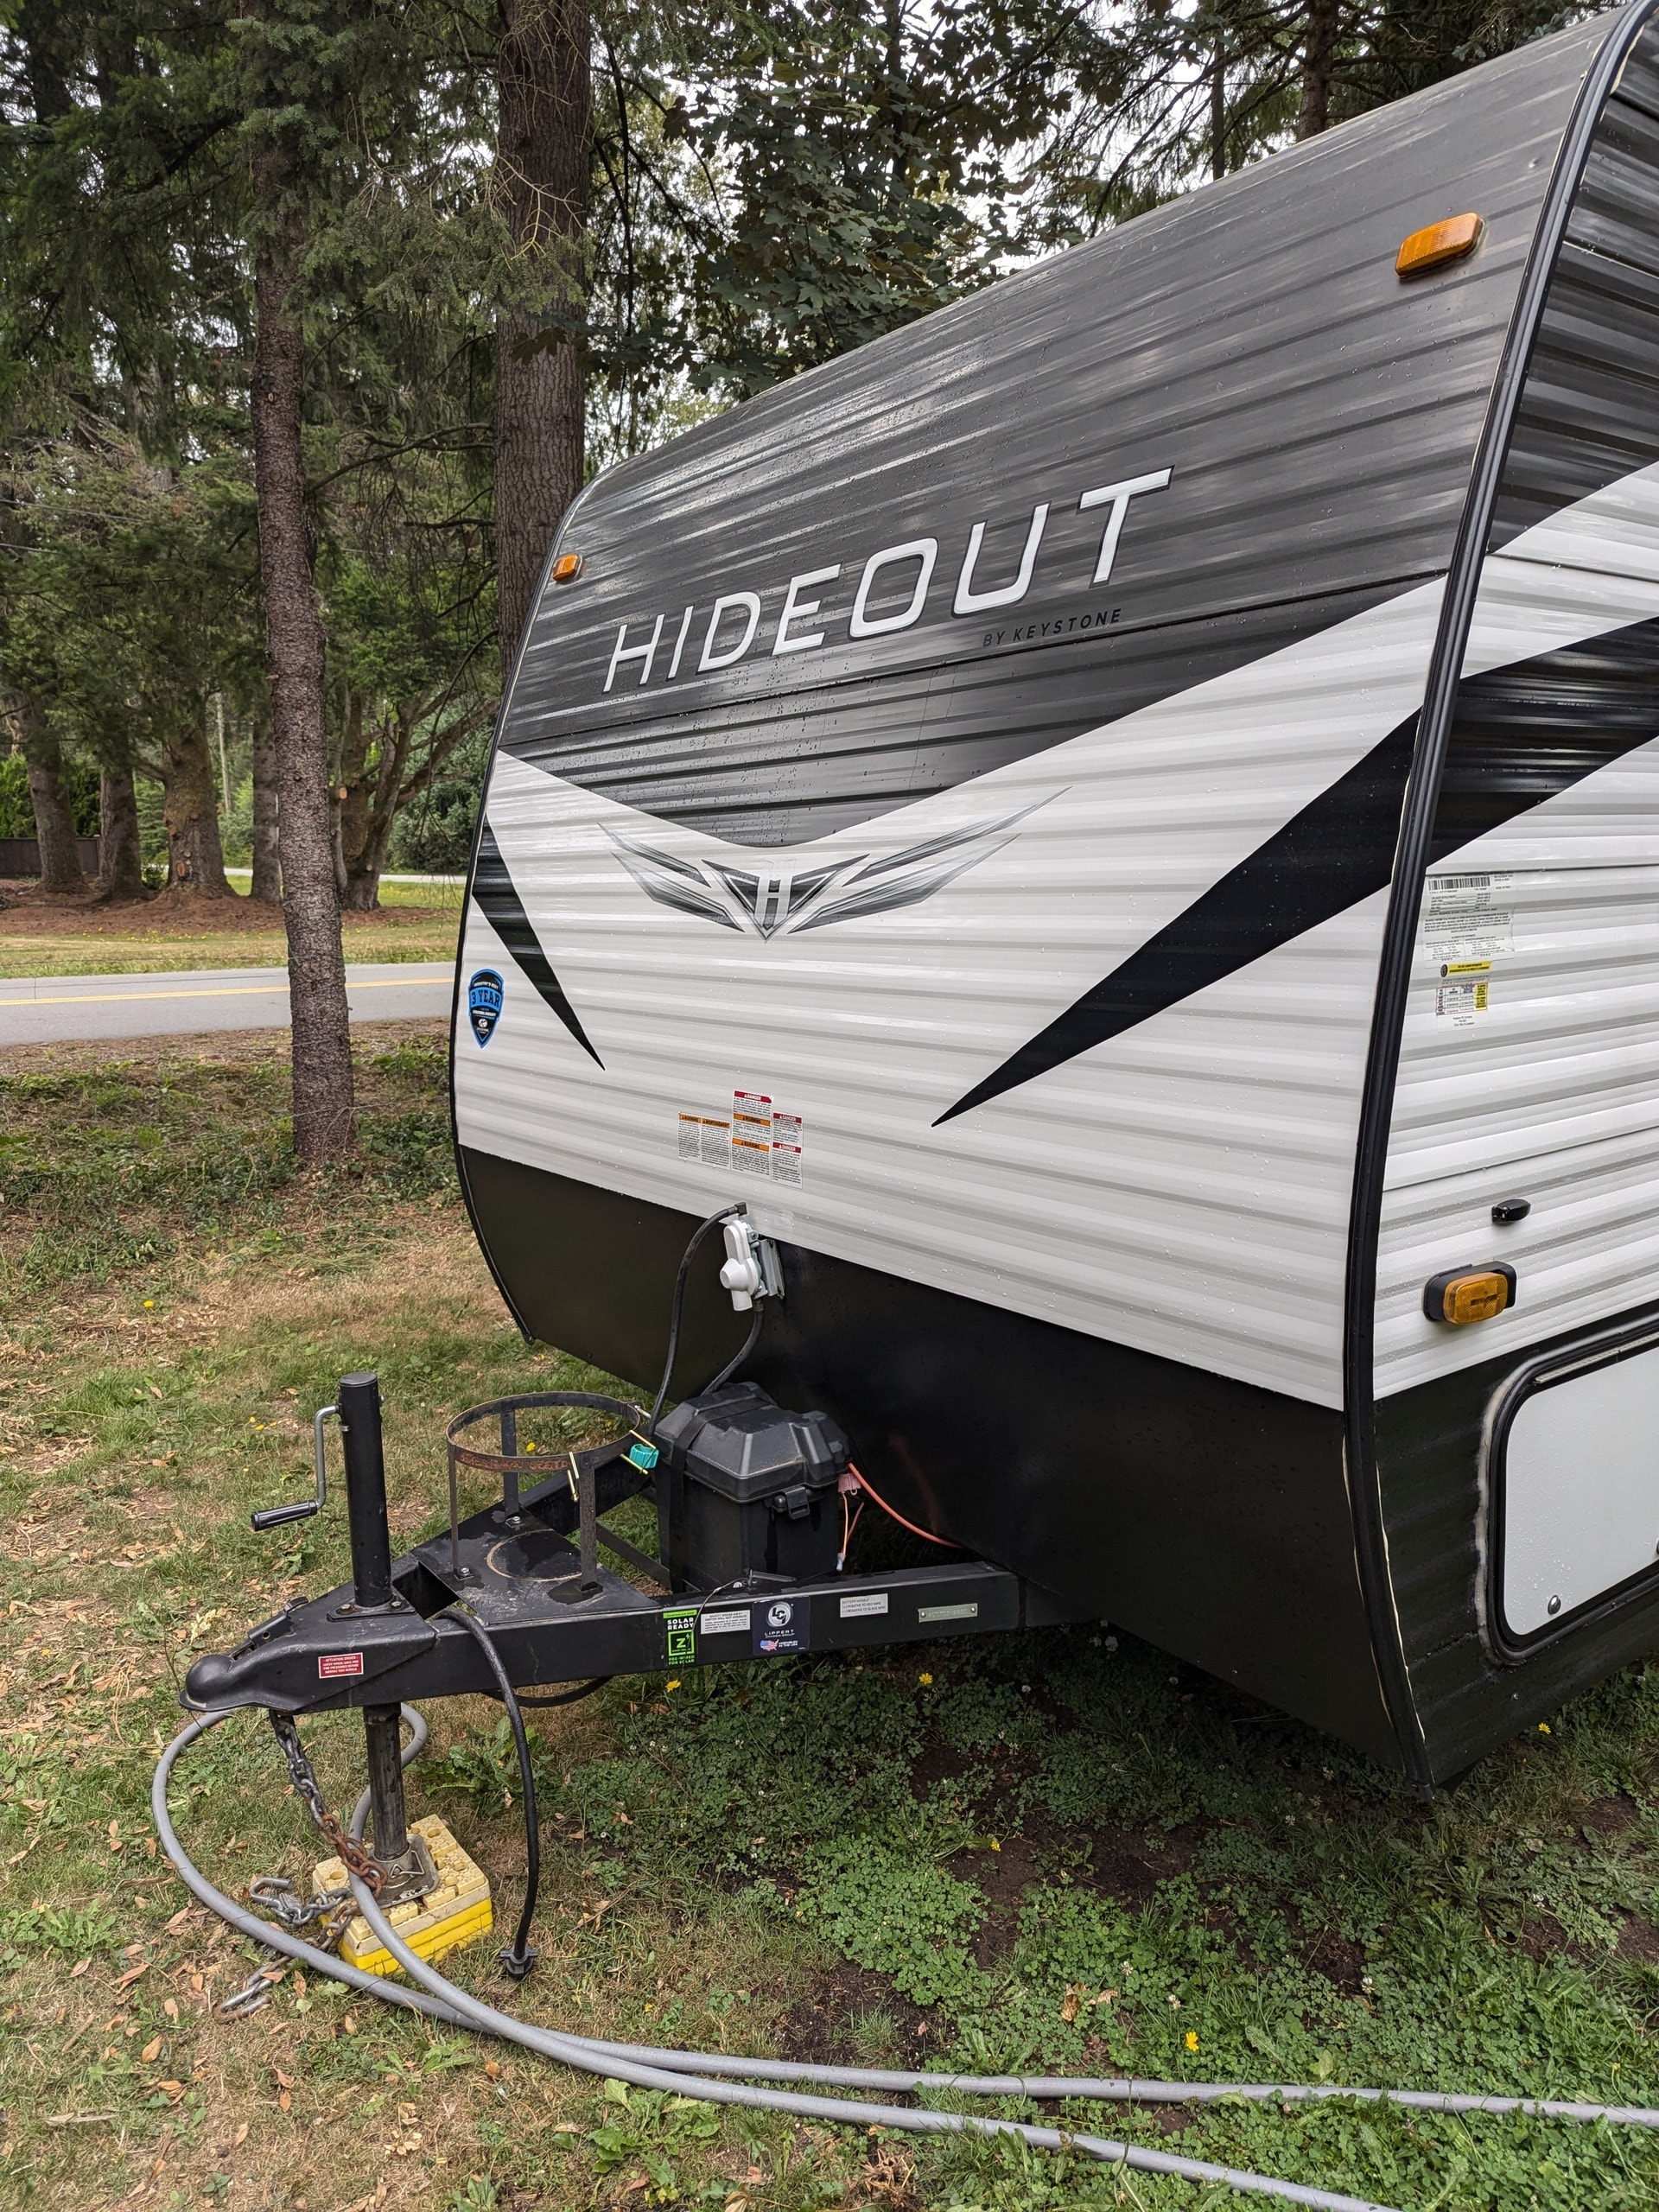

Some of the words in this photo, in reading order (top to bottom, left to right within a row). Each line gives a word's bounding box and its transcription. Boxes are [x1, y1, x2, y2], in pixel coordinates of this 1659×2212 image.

[603, 466, 1173, 692] HIDEOUT
[982, 631, 1005, 647] BY
[1013, 608, 1122, 642] KEYSTONE
[472, 991, 476, 1006] 3
[478, 989, 499, 1008] YEAR
[667, 1617, 694, 1625] SOLAR
[676, 1637, 686, 1649] Z
